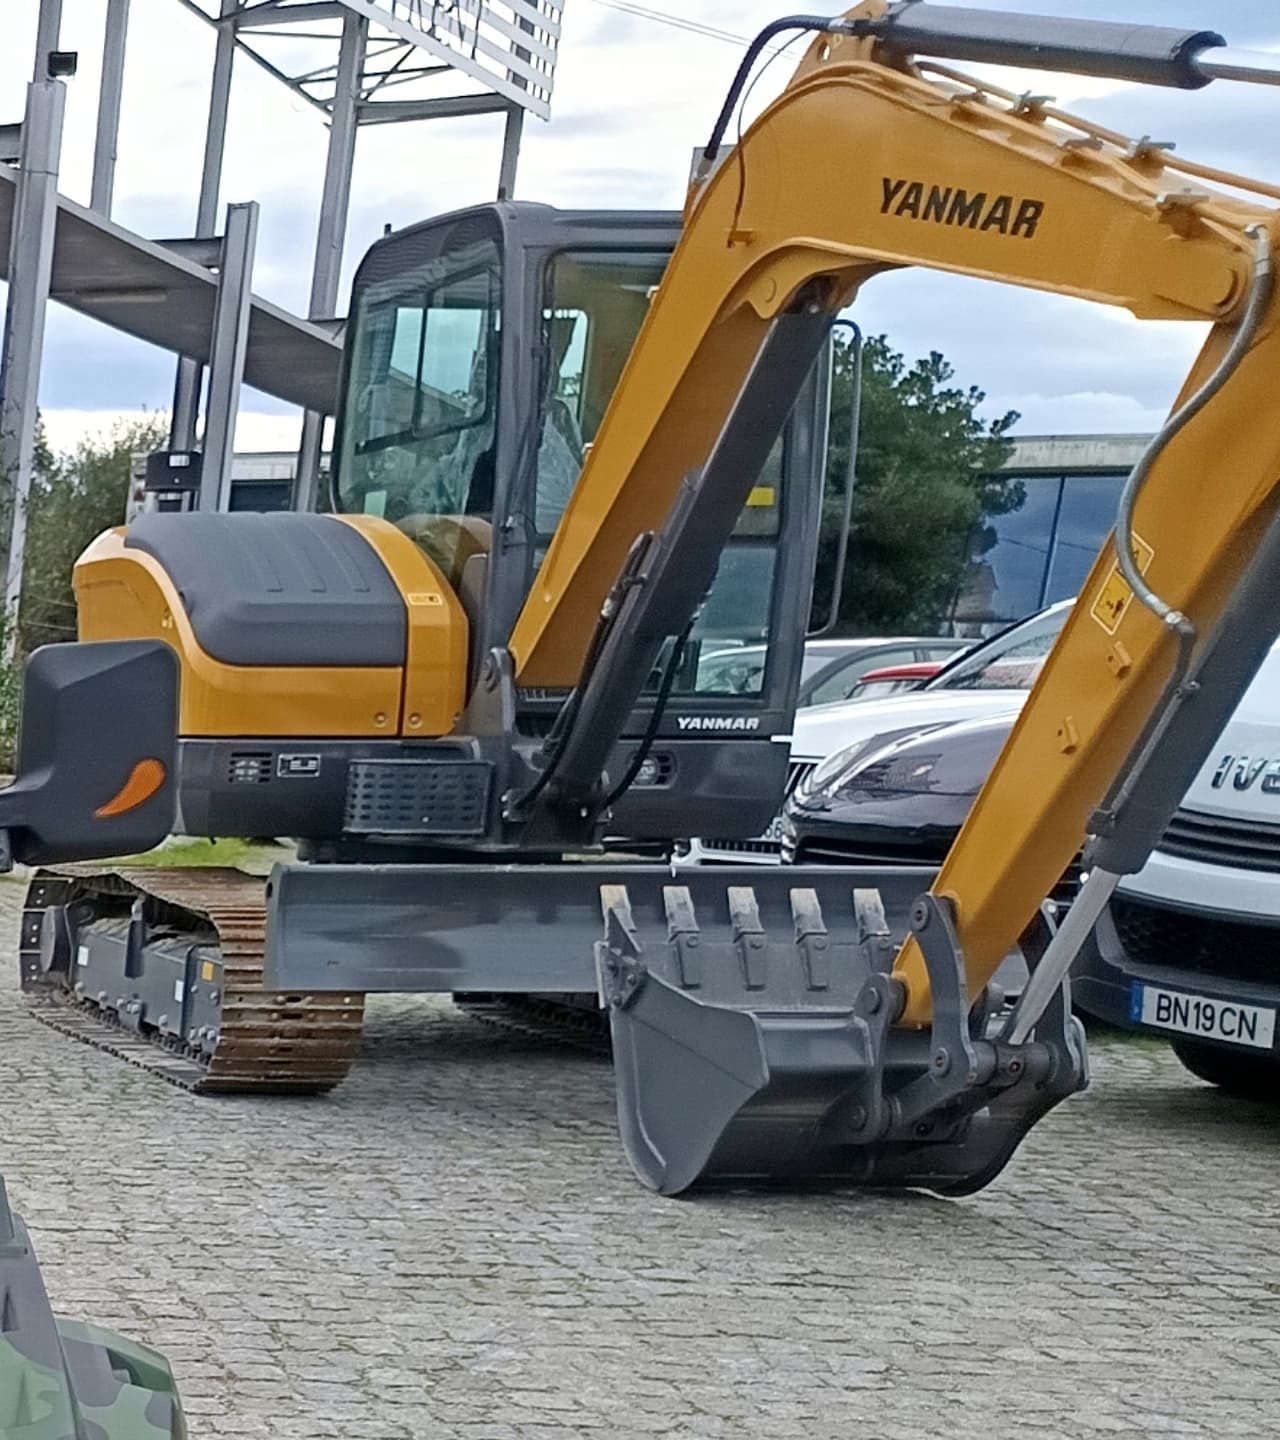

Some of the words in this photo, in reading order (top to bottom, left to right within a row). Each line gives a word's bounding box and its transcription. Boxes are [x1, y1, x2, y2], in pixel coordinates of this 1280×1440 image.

[880, 177, 1045, 239] YANMAR
[678, 716, 759, 730] YANMAR
[1156, 993, 1258, 1041] BN19CN
